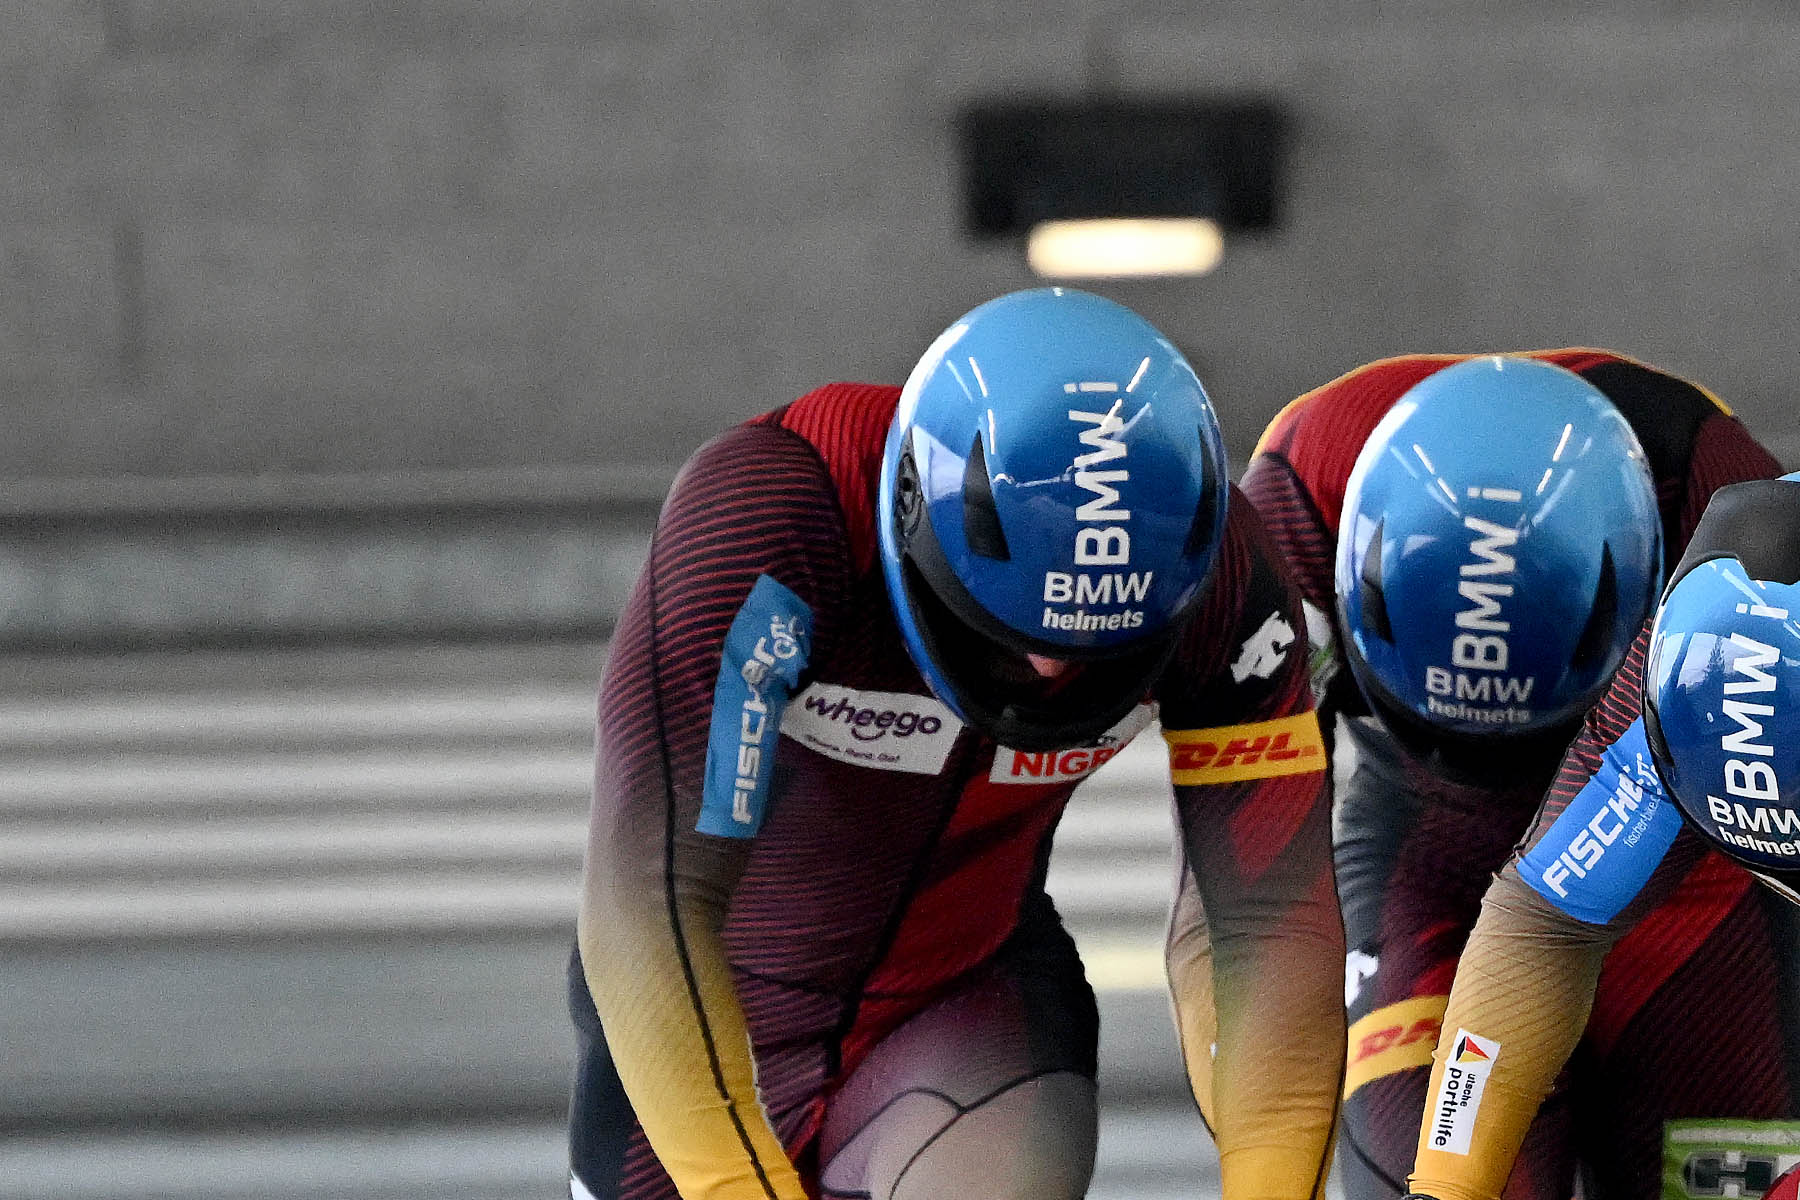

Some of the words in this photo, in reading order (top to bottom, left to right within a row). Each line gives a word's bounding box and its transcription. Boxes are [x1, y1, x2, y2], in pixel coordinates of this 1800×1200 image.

[1068, 410, 1130, 565] BMW
[1043, 570, 1153, 604] BMW
[1451, 516, 1521, 671] BMW
[1042, 608, 1144, 631] helmets
[1425, 666, 1535, 703] BMW
[805, 696, 942, 737] wheego
[1427, 698, 1531, 724] helmets
[1722, 632, 1781, 802] BMW
[1011, 743, 1128, 777] NIGR
[1174, 733, 1301, 770] DHL
[1357, 1018, 1441, 1062] DH
[1435, 1067, 1462, 1146] porthilfe
